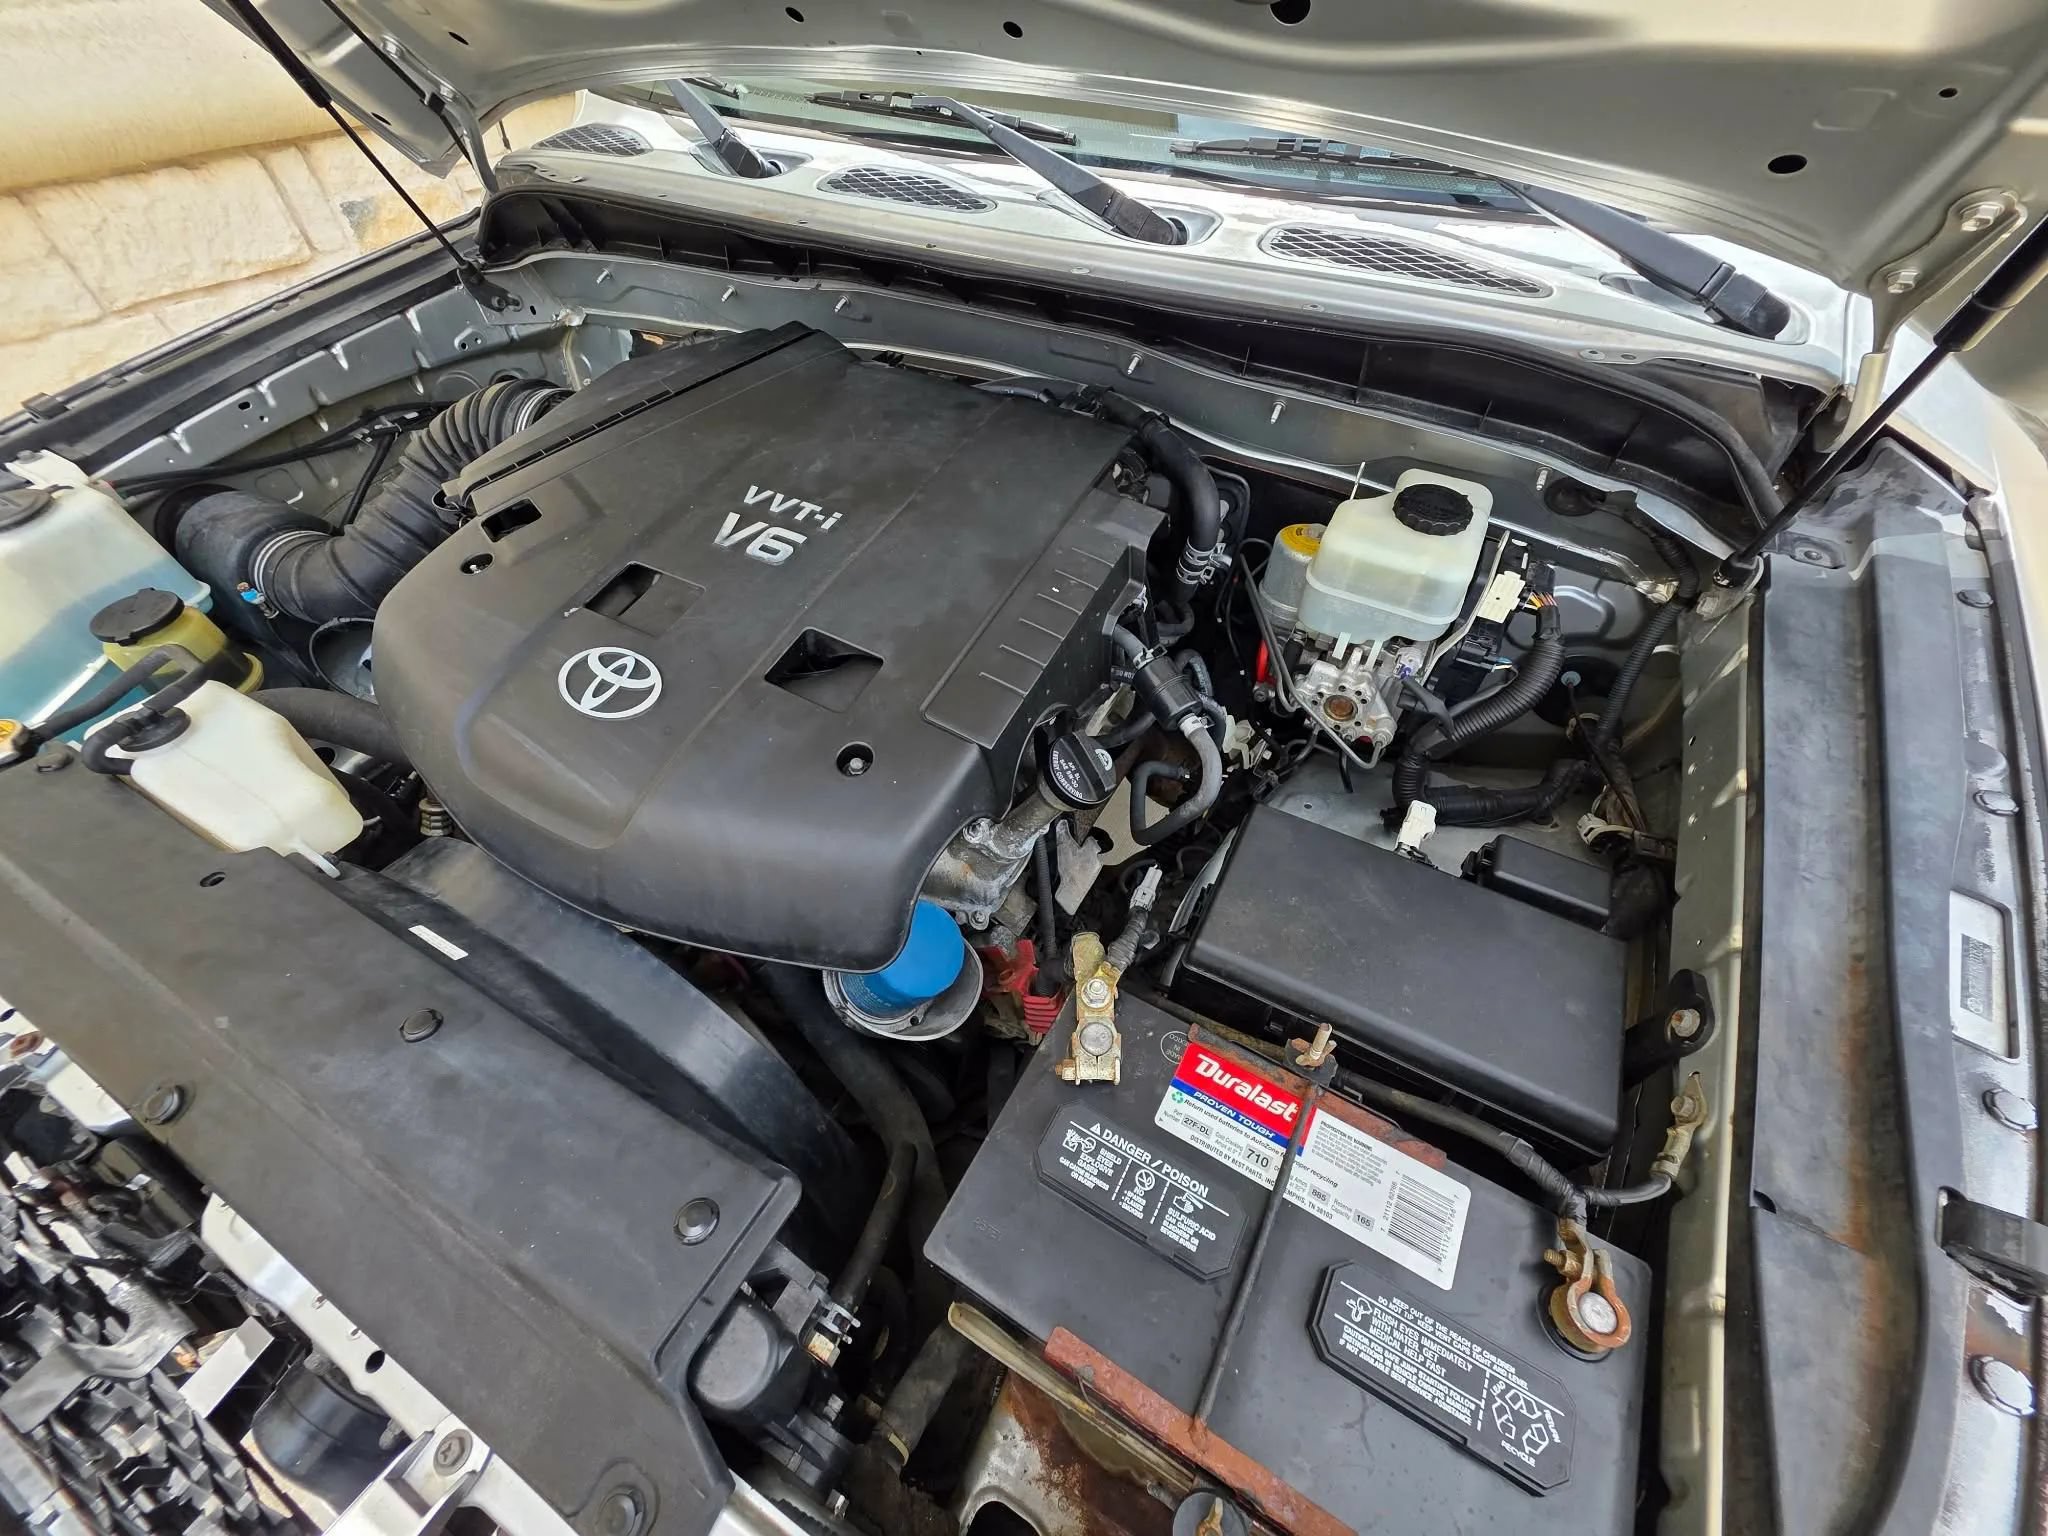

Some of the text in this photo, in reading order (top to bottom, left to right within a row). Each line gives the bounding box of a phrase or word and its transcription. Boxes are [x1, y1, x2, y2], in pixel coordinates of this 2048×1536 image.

[744, 485, 843, 530] VVT-i
[713, 512, 808, 565] V6
[1056, 771, 1083, 799] CONSERVING
[1060, 759, 1078, 788] SAE 5W-30
[1195, 1053, 1299, 1122] Duralast
[1183, 1117, 1210, 1135] 27F-DL
[1184, 1099, 1203, 1112] Return
[1203, 1110, 1217, 1120] used
[1218, 1118, 1243, 1134] batteries
[1250, 1136, 1279, 1154] AutoZone
[1193, 1091, 1274, 1139] PROVEN TOUGH
[1059, 1156, 1070, 1166] CAN
[1076, 1159, 1098, 1175] GASES
[1080, 1152, 1113, 1176] EXPLOSIVE
[1096, 1154, 1113, 1168] EYES
[1100, 1148, 1122, 1165] SHIELD
[1102, 1129, 1150, 1163] DANGER
[1161, 1163, 1208, 1197] POISON
[1189, 1134, 1223, 1156] DISTRIBUTED
[1231, 1158, 1244, 1168] BEST
[1244, 1148, 1270, 1168] 710
[1294, 1159, 1309, 1171] roper
[1310, 1168, 1338, 1188] recycling
[1134, 1186, 1145, 1196] NO
[1311, 1189, 1326, 1201] 885
[1165, 1214, 1194, 1235] CAN CAUSE
[1167, 1207, 1216, 1241] SULFURIC ACID
[1356, 1214, 1371, 1226] 165
[1369, 1325, 1446, 1377] MEDICAL HELP FAST
[1371, 1316, 1391, 1334] WITH
[1423, 1347, 1438, 1362] GET
[1374, 1307, 1472, 1372] FLUSH EYES IMMEDIATELY
[1378, 1296, 1388, 1306] DO
[1389, 1302, 1402, 1314] NOT
[1417, 1319, 1434, 1333] KEEP
[1436, 1330, 1451, 1343] VENT
[1453, 1340, 1471, 1355] CAPS
[1473, 1351, 1491, 1366] TIGHT
[1494, 1364, 1508, 1376] AND
[1393, 1297, 1516, 1374] KEEP OUT OF THE REACH OF CHILDREN
[1342, 1332, 1384, 1362] INSTRUCTIONS
[1385, 1358, 1392, 1367] IN
[1393, 1363, 1418, 1383] VEHICLE
[1446, 1396, 1471, 1415] MANUAL
[1346, 1342, 1359, 1354] NOT
[1391, 1370, 1406, 1384] SEEK
[1407, 1380, 1434, 1401] SERVICE
[1434, 1397, 1472, 1425] ASSISTANCE
[1370, 1341, 1383, 1354] FOR
[1385, 1350, 1400, 1364] SAFE
[1401, 1360, 1417, 1374] JUMP
[1418, 1371, 1448, 1393] STARTING
[1448, 1389, 1475, 1410] FOLLOW
[1544, 1409, 1560, 1443] RETURN
[1501, 1440, 1536, 1467] RECYCLE
